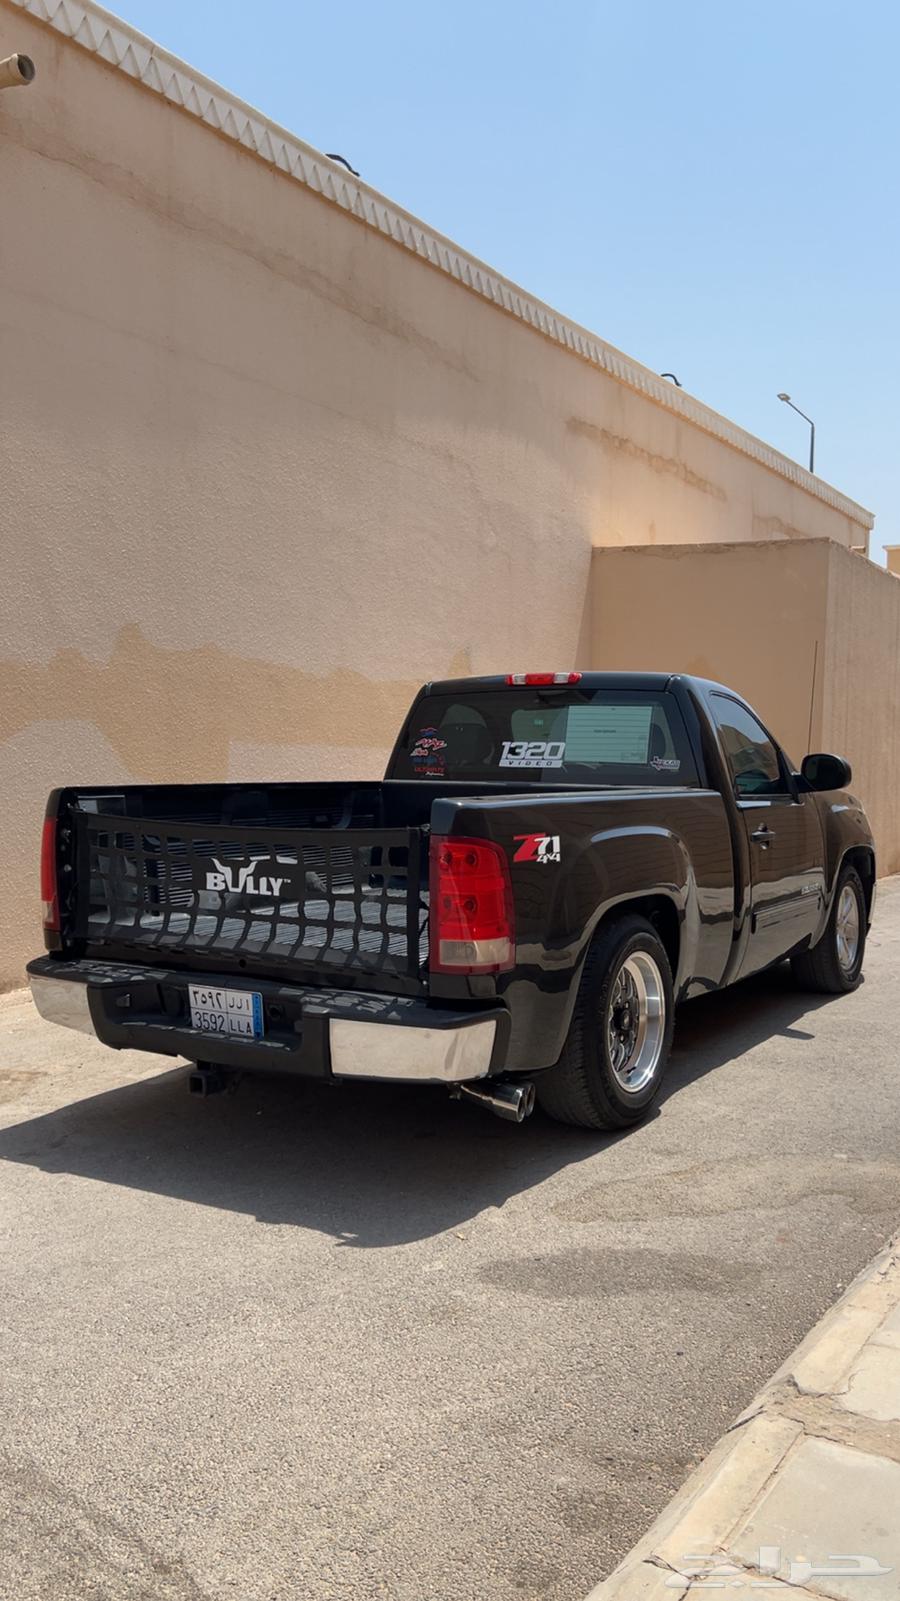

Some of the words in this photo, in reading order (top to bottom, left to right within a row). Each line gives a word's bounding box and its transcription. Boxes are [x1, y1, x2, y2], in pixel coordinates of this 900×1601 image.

[501, 741, 566, 760] 1320
[513, 832, 560, 862] Z71
[205, 857, 283, 897] BULLY
[192, 990, 222, 1010] ٣٥٩٢
[194, 1011, 226, 1033] 3592
[230, 1019, 253, 1034] LLA
